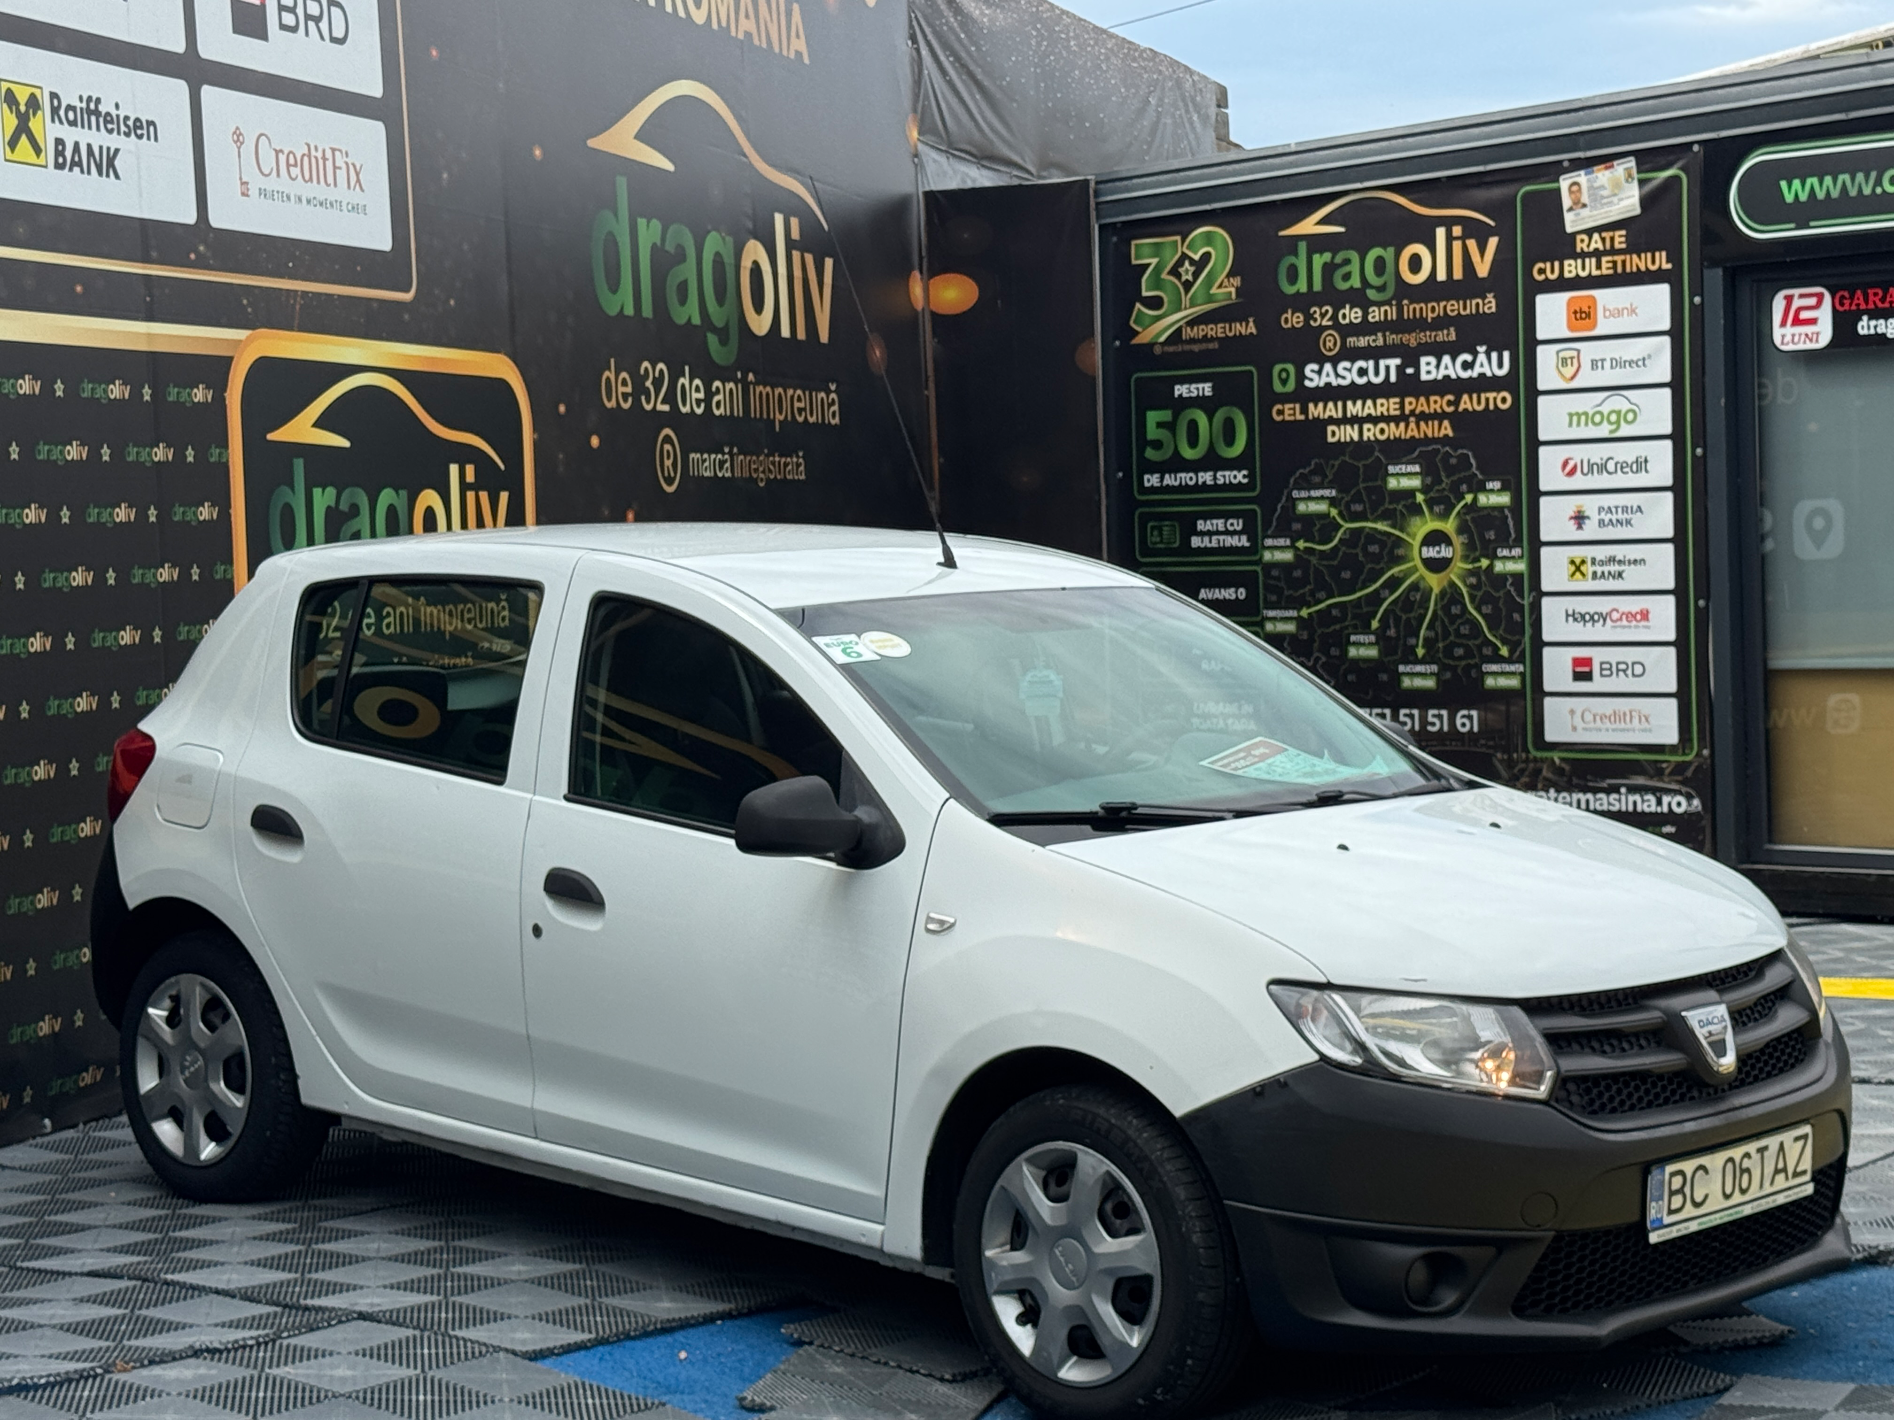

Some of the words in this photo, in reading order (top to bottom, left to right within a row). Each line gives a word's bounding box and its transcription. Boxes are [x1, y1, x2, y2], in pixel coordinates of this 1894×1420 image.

[278, 0, 349, 45] BRD
[48, 91, 158, 142] Raiffeisen
[53, 138, 121, 181] BANK
[254, 132, 365, 193] CreditFix
[258, 187, 291, 203] PRIETEN
[306, 196, 343, 212] MOMENTE
[1575, 230, 1627, 253] RATE
[591, 175, 834, 366] dragoliv
[1277, 225, 1499, 301] dragoliv
[1532, 261, 1560, 282] CU
[1563, 251, 1672, 279] BULETINUL
[1129, 225, 1235, 331] 32
[1222, 276, 1241, 288] ANI
[1280, 309, 1304, 328] de
[1309, 305, 1333, 327] 32
[1338, 304, 1362, 324] de
[1367, 301, 1397, 323] ani
[1402, 293, 1497, 323] împreună
[1572, 306, 1592, 321] tbi
[1602, 303, 1638, 320] bank
[1780, 292, 1824, 328] 12
[1834, 287, 1894, 312] GARA
[1181, 317, 1257, 340] ÎMPREUNĂ
[1346, 331, 1384, 349] marcă
[1385, 327, 1456, 347] înregistrată
[1780, 331, 1821, 346] LUNI
[1857, 314, 1894, 338] drag
[1303, 358, 1401, 389] SASCUT
[1420, 345, 1511, 381] BACĂU
[1561, 356, 1575, 368] BT
[1590, 357, 1607, 371] BT
[79, 379, 130, 404] dragoliv
[166, 383, 213, 407] dragoliv
[601, 358, 633, 409] de
[640, 361, 670, 412] 32
[677, 365, 705, 415] de
[712, 371, 743, 417] ani
[747, 371, 840, 431] împreună
[1174, 382, 1213, 398] PESTE
[1272, 403, 1305, 421] CEL
[1308, 400, 1343, 420] MAI
[1346, 398, 1401, 417] MARE
[1404, 395, 1455, 415] PARC
[1458, 391, 1512, 412] AUTO
[1144, 406, 1248, 462] 500
[1326, 425, 1359, 443] DIN
[1362, 417, 1454, 441] ROMÂNIA
[1567, 408, 1638, 435] mogo
[35, 440, 88, 465] dragoliv
[125, 442, 174, 466] dragoliv
[689, 446, 732, 478] marcă
[733, 446, 806, 486] înregistrată
[1144, 474, 1161, 487] DE
[1162, 472, 1197, 486] AUTO
[1198, 471, 1214, 485] PE
[1215, 470, 1249, 485] STOC
[1580, 456, 1650, 477] UniCredit
[86, 502, 136, 527] dragoliv
[172, 501, 218, 526] dragoliv
[1597, 504, 1644, 516] PATRIA
[1197, 519, 1225, 532] RATE
[1226, 518, 1243, 531] CU
[1598, 517, 1634, 529] BANK
[1191, 534, 1250, 548] BULETINUL
[1421, 543, 1453, 559] BACĂU
[1590, 555, 1646, 568] Raiffeisen
[41, 566, 94, 592] dragoliv
[130, 563, 179, 588] dragoliv
[1591, 569, 1625, 581] BANK
[1198, 588, 1236, 601] AVANS
[1237, 587, 1246, 600] 0
[382, 597, 413, 635] ani
[419, 593, 509, 640] împreună
[1565, 608, 1651, 627] HappyCredit
[0, 631, 52, 659] dragoliv
[90, 625, 141, 650] dragoliv
[823, 640, 859, 649] EURO
[841, 647, 863, 658] 6
[1599, 661, 1646, 679] BRD
[45, 691, 98, 718] dragoliv
[1581, 708, 1650, 726] CreditFix
[1399, 708, 1419, 732] 51
[1427, 708, 1449, 732] 51
[1455, 709, 1479, 733] 61
[3, 759, 56, 787] dragoliv
[1528, 786, 1687, 814] atemasina.ro
[50, 816, 102, 844] dragoliv
[6, 887, 59, 916] dragoliv
[8, 1014, 61, 1045] dragoliv
[1698, 1014, 1727, 1029] DACIA
[1666, 1164, 1709, 1217] BC
